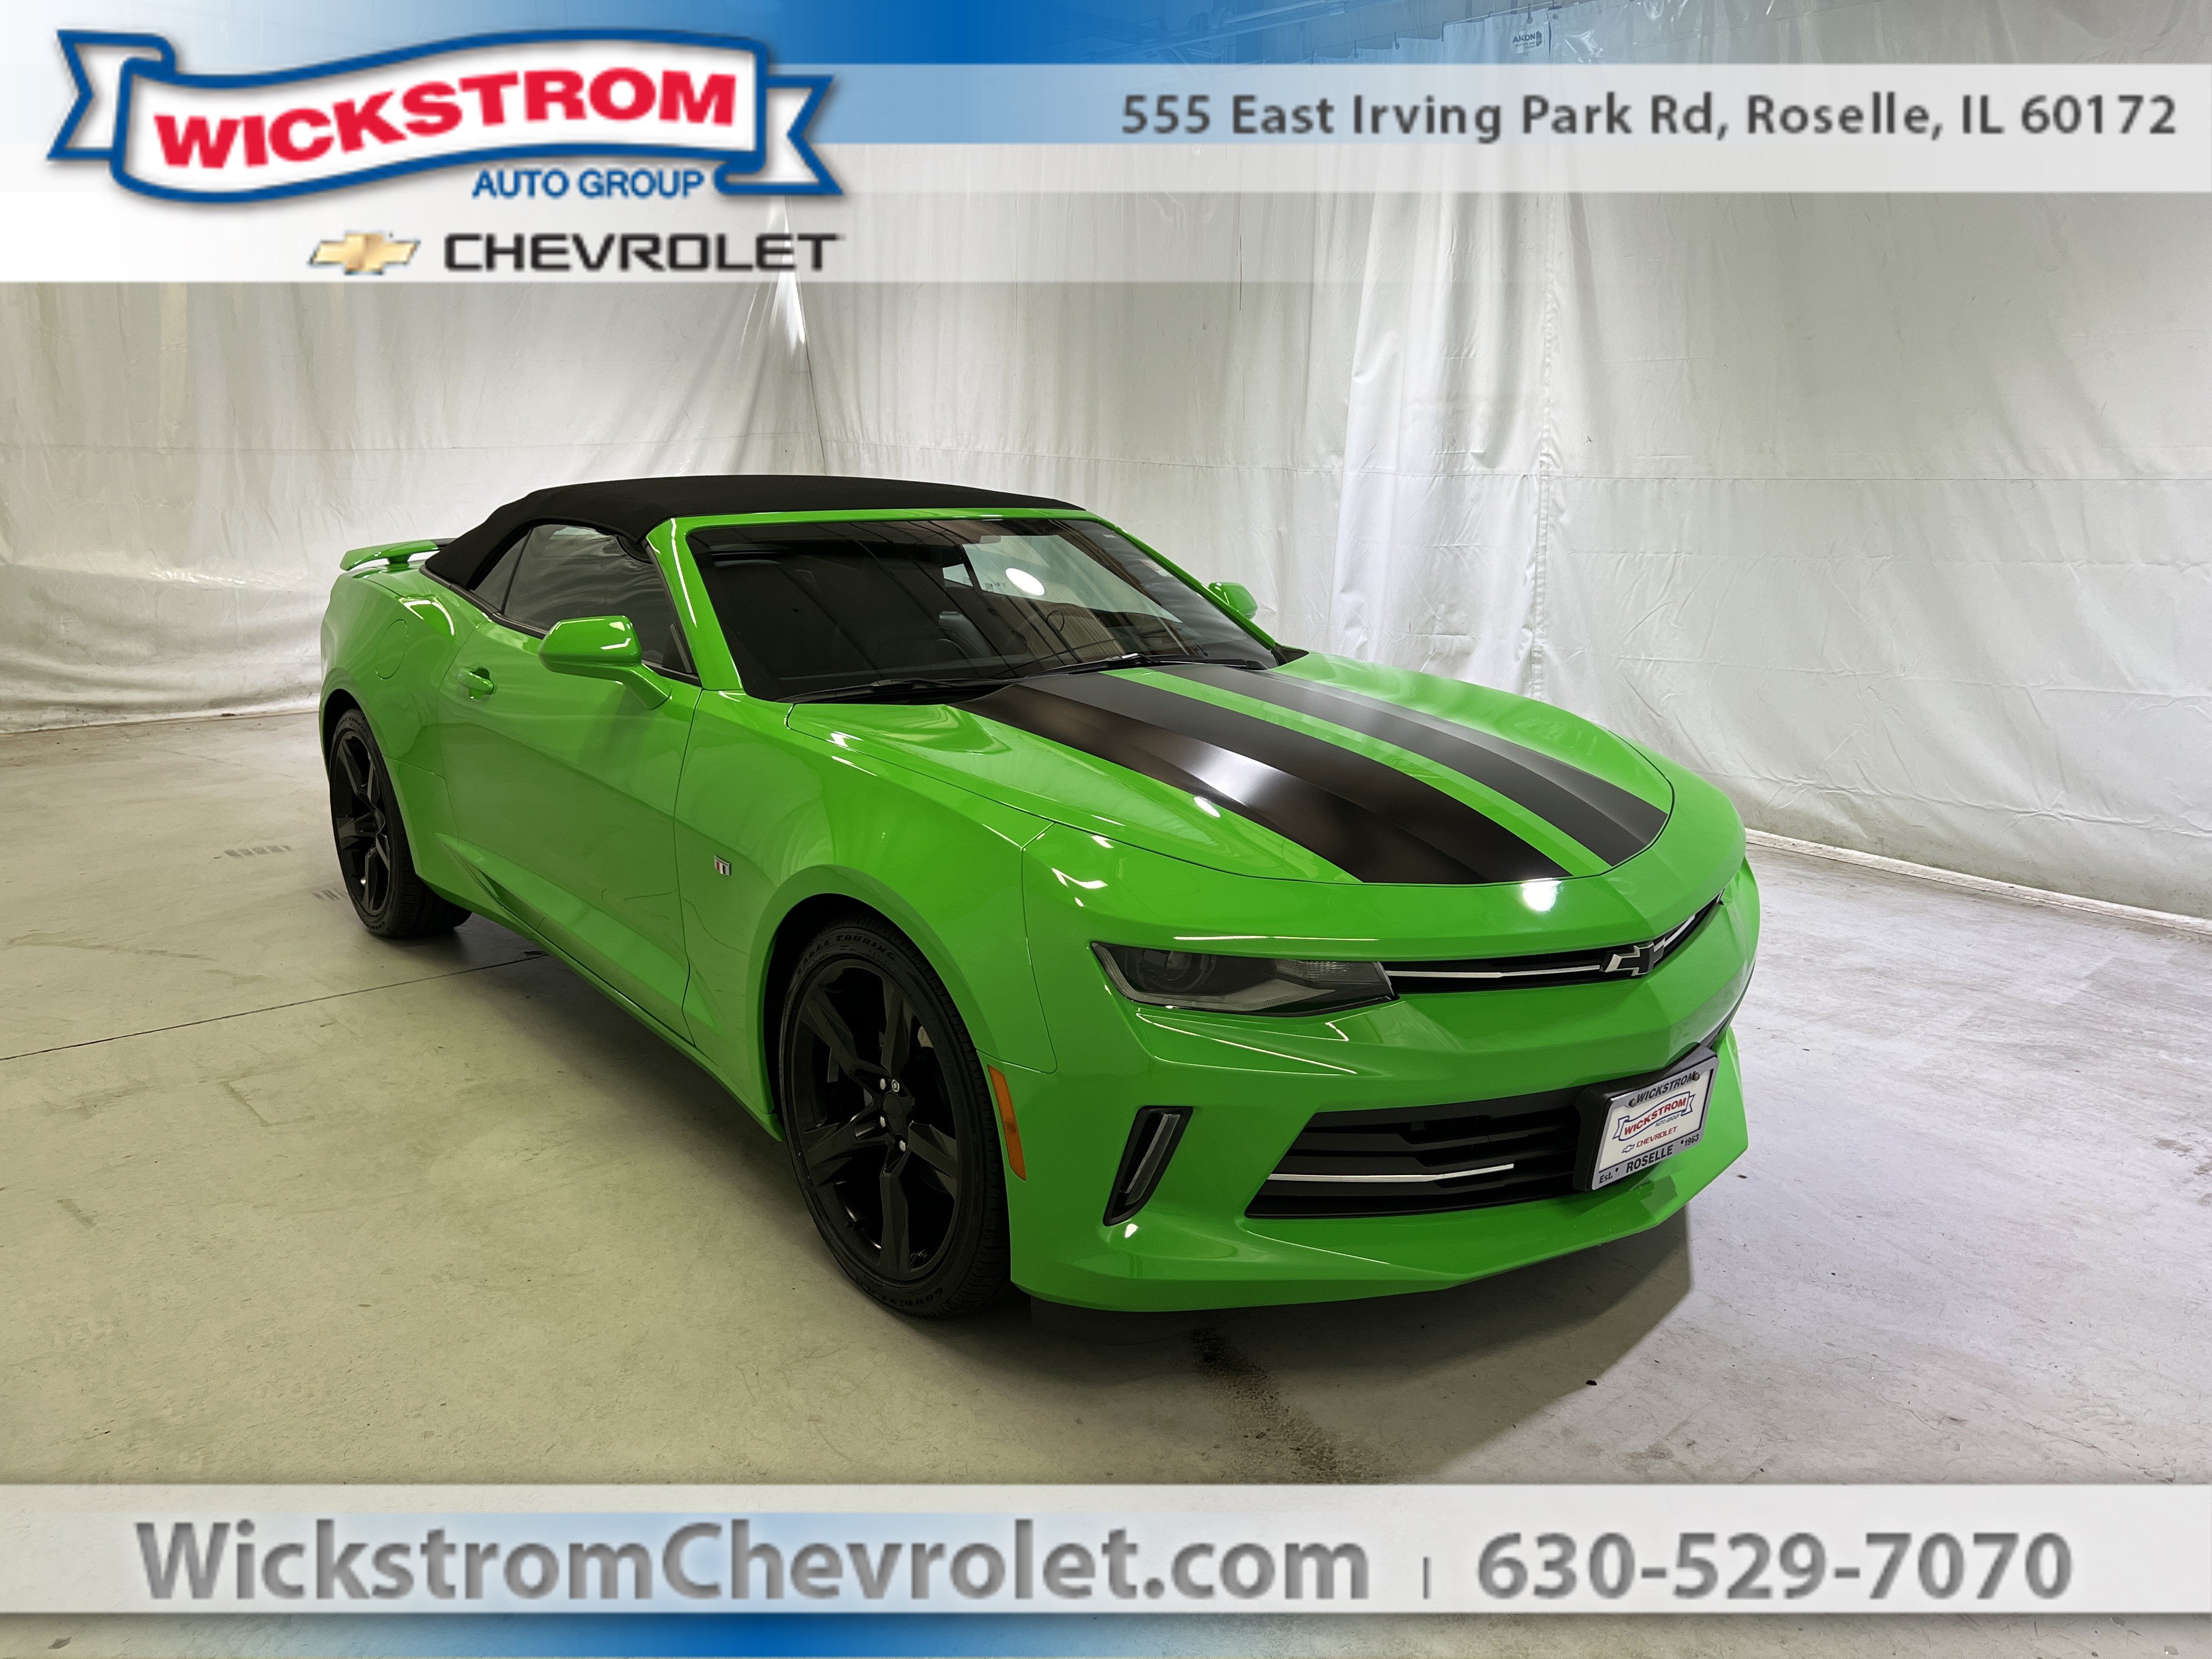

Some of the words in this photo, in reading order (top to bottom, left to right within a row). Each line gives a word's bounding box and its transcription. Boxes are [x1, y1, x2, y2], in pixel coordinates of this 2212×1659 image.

[1512, 33, 1536, 43] AKON
[836, 934, 897, 961] TOURING
[1624, 1097, 1686, 1136] WICKSTROM
[1636, 1126, 1678, 1148] CHEVROLET
[1626, 1144, 1674, 1173] ROSELLE
[1684, 1133, 1700, 1147] 1963
